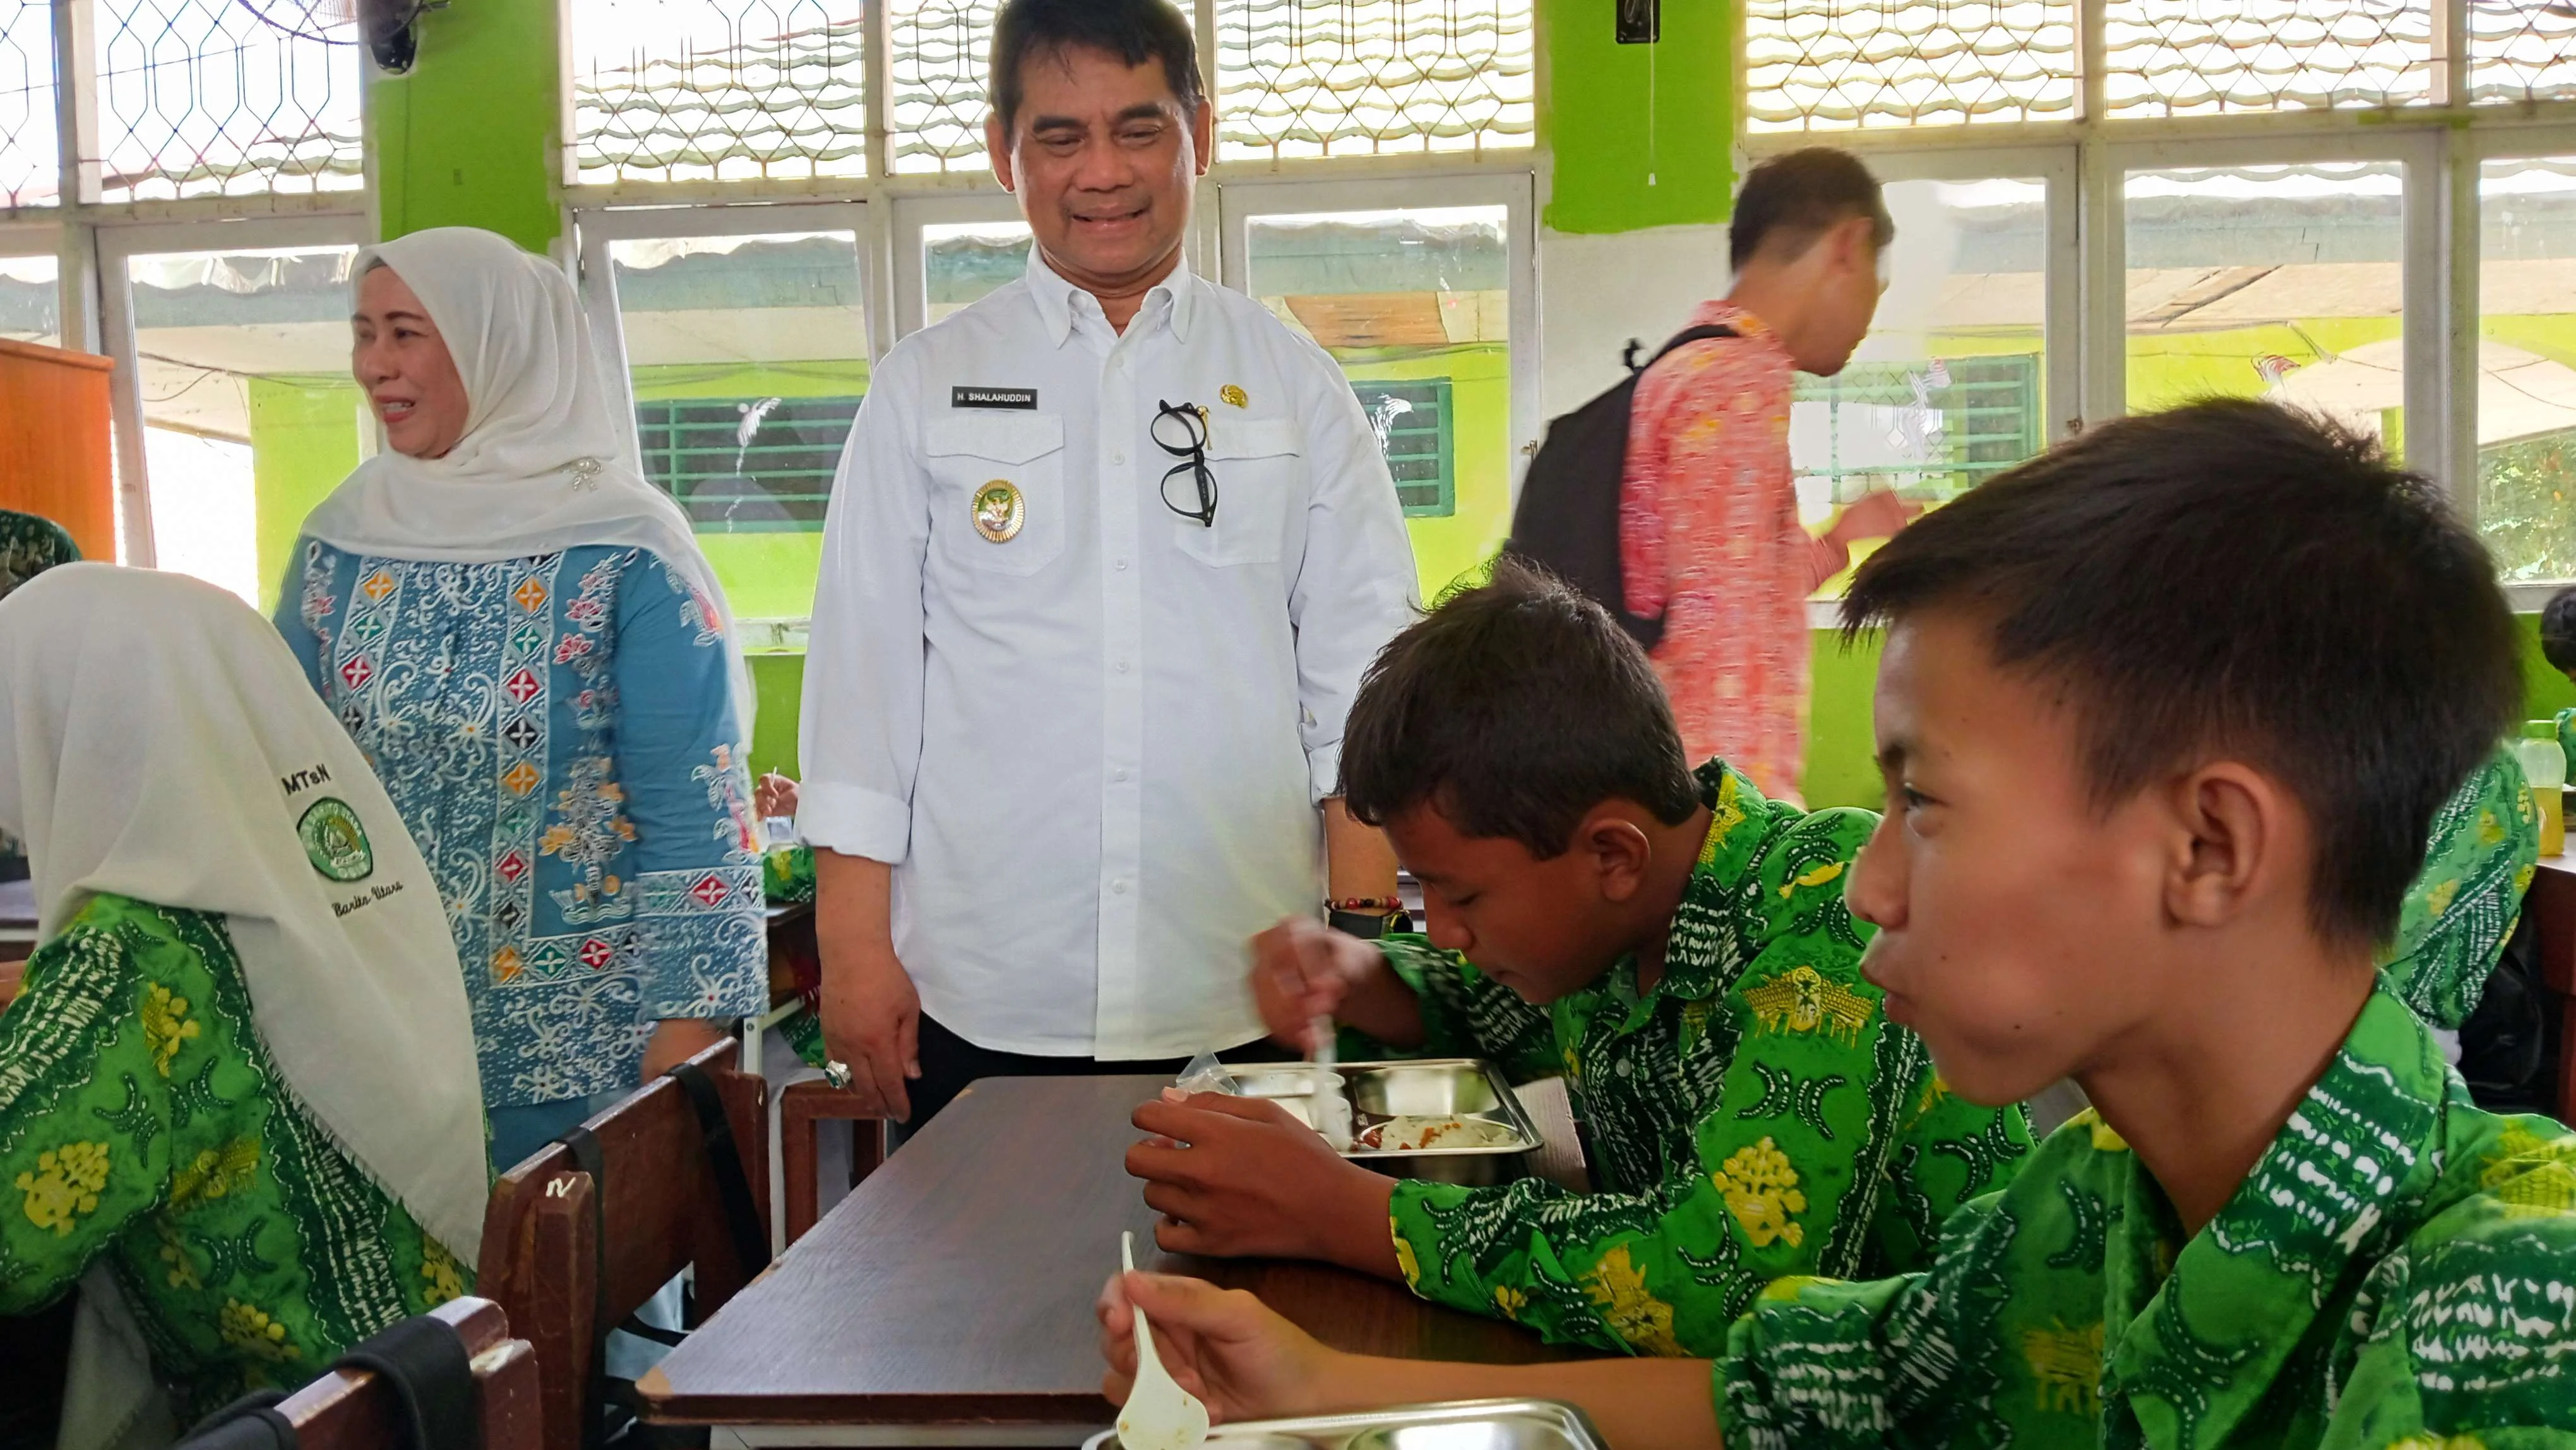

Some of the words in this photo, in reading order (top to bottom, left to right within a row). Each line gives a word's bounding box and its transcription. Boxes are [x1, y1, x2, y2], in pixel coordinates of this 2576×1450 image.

[957, 392, 966, 401] H.
[968, 392, 1031, 403] SHALAHUDDIN
[281, 763, 332, 796] MTsN
[371, 880, 403, 901] Utara
